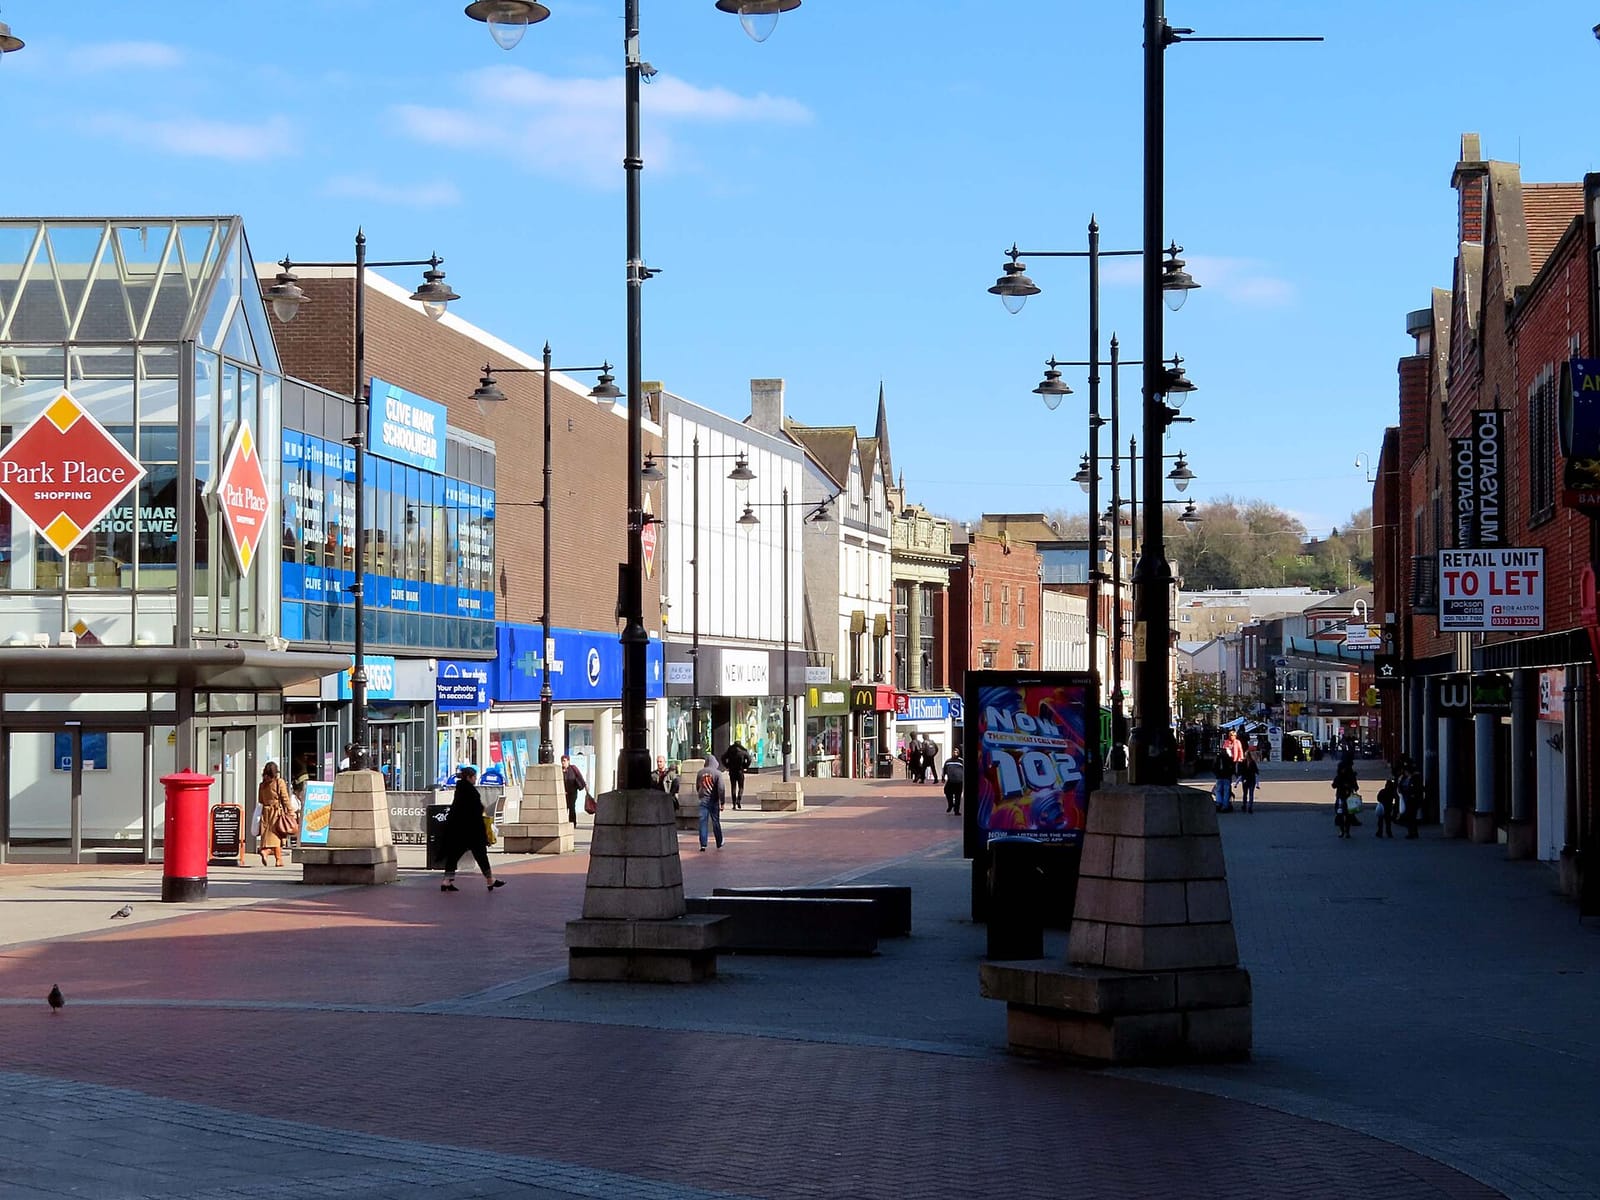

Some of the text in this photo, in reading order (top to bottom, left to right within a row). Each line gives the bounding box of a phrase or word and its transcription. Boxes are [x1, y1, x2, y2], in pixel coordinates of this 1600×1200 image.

[385, 396, 435, 434] CLIVE MARK
[382, 422, 437, 459] SCHOOLWEAR
[1, 460, 125, 483] Park Place
[1478, 412, 1498, 541] FOOTASYLUM
[34, 491, 91, 500] SHOPPING
[226, 483, 265, 512] Park Place
[139, 507, 177, 518] MAR
[1443, 552, 1539, 567] RETAIL UNIT
[305, 578, 321, 590] CLIVE
[1443, 570, 1539, 596] TO LET
[391, 588, 418, 602] CLIVE MARK
[458, 597, 480, 610] CLIVE MARK
[1450, 600, 1482, 608] jackson
[364, 664, 392, 690] REGGS
[726, 664, 768, 682] NEW LOOK
[454, 684, 477, 693] photos
[985, 705, 1059, 736] NOW
[989, 749, 1082, 797] 102
[390, 807, 426, 816] GREGGS
